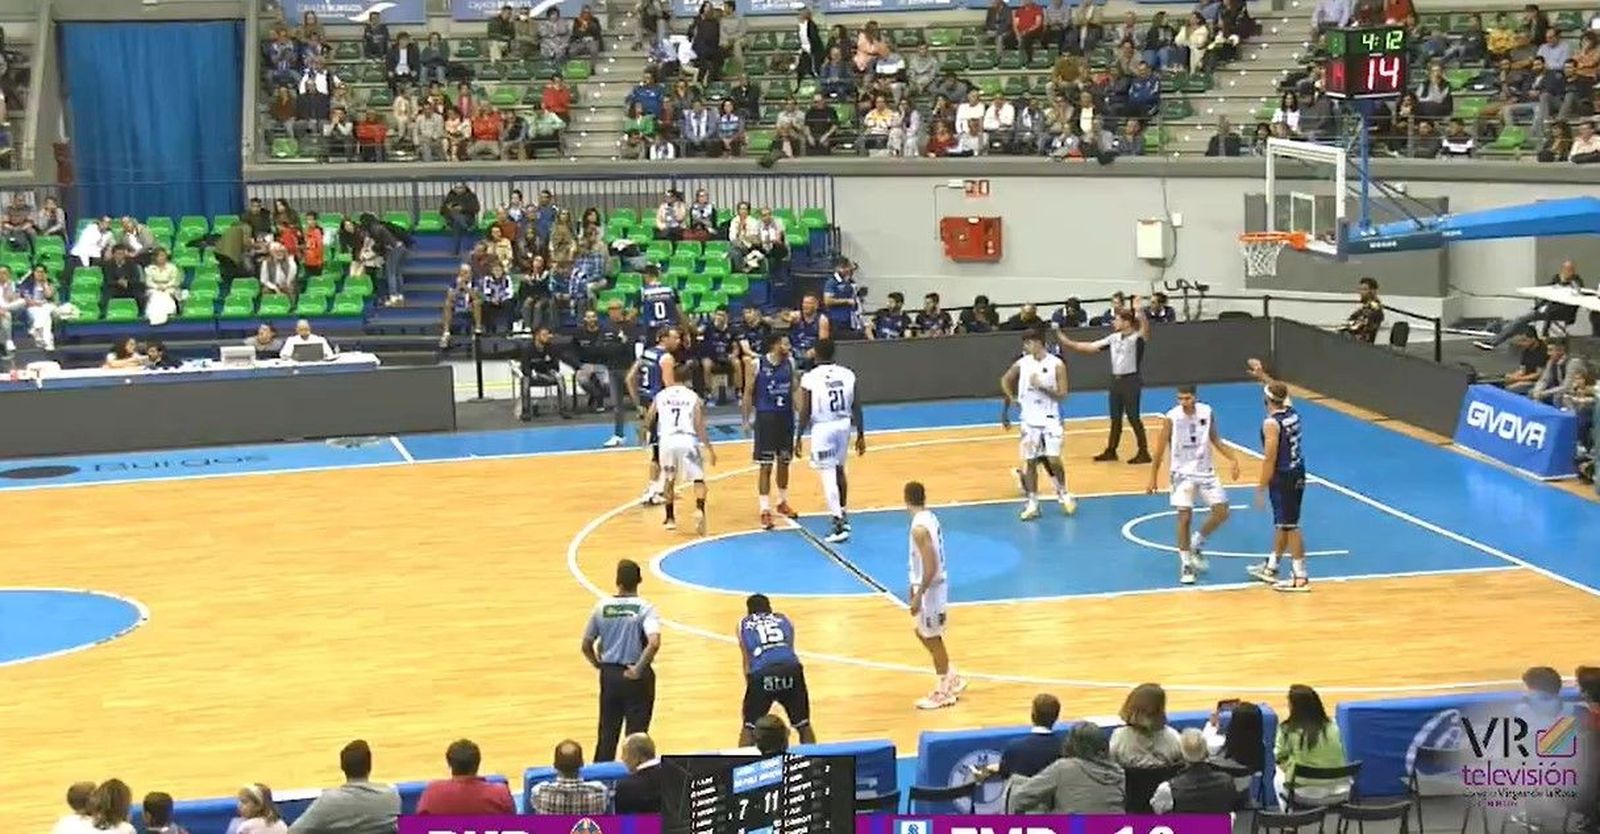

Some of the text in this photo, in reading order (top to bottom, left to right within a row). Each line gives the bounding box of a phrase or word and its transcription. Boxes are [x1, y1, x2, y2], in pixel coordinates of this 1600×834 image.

[1362, 30, 1403, 51] 4:12
[1367, 57, 1399, 91] 14
[654, 301, 666, 319] 0
[828, 389, 846, 412] 21
[671, 408, 681, 427] 7
[1467, 400, 1547, 450] GIVOVA
[756, 622, 785, 644] 15
[739, 798, 749, 821] 7
[764, 789, 779, 814] 11
